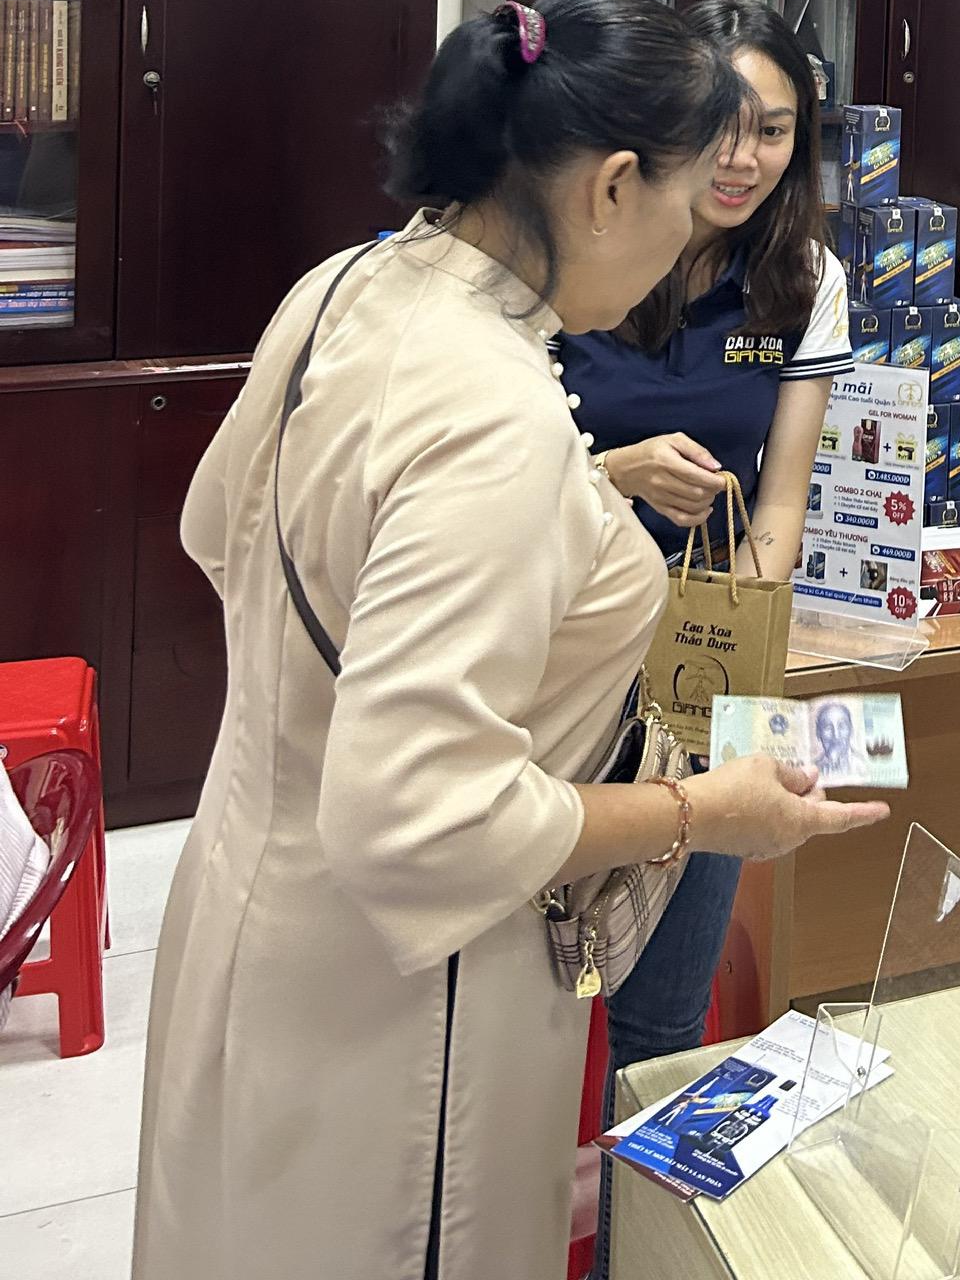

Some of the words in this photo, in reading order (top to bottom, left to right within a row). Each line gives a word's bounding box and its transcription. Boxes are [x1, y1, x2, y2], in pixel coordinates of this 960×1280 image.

[759, 336, 782, 351] XOA
[843, 382, 873, 395] mãi
[894, 413, 917, 421] WOMAN
[834, 485, 859, 495] COMBO
[866, 490, 881, 498] CHAI
[891, 499, 906, 511] 5%
[804, 527, 823, 535] OMBO
[683, 621, 704, 634] Cao
[708, 624, 732, 638] Xoa
